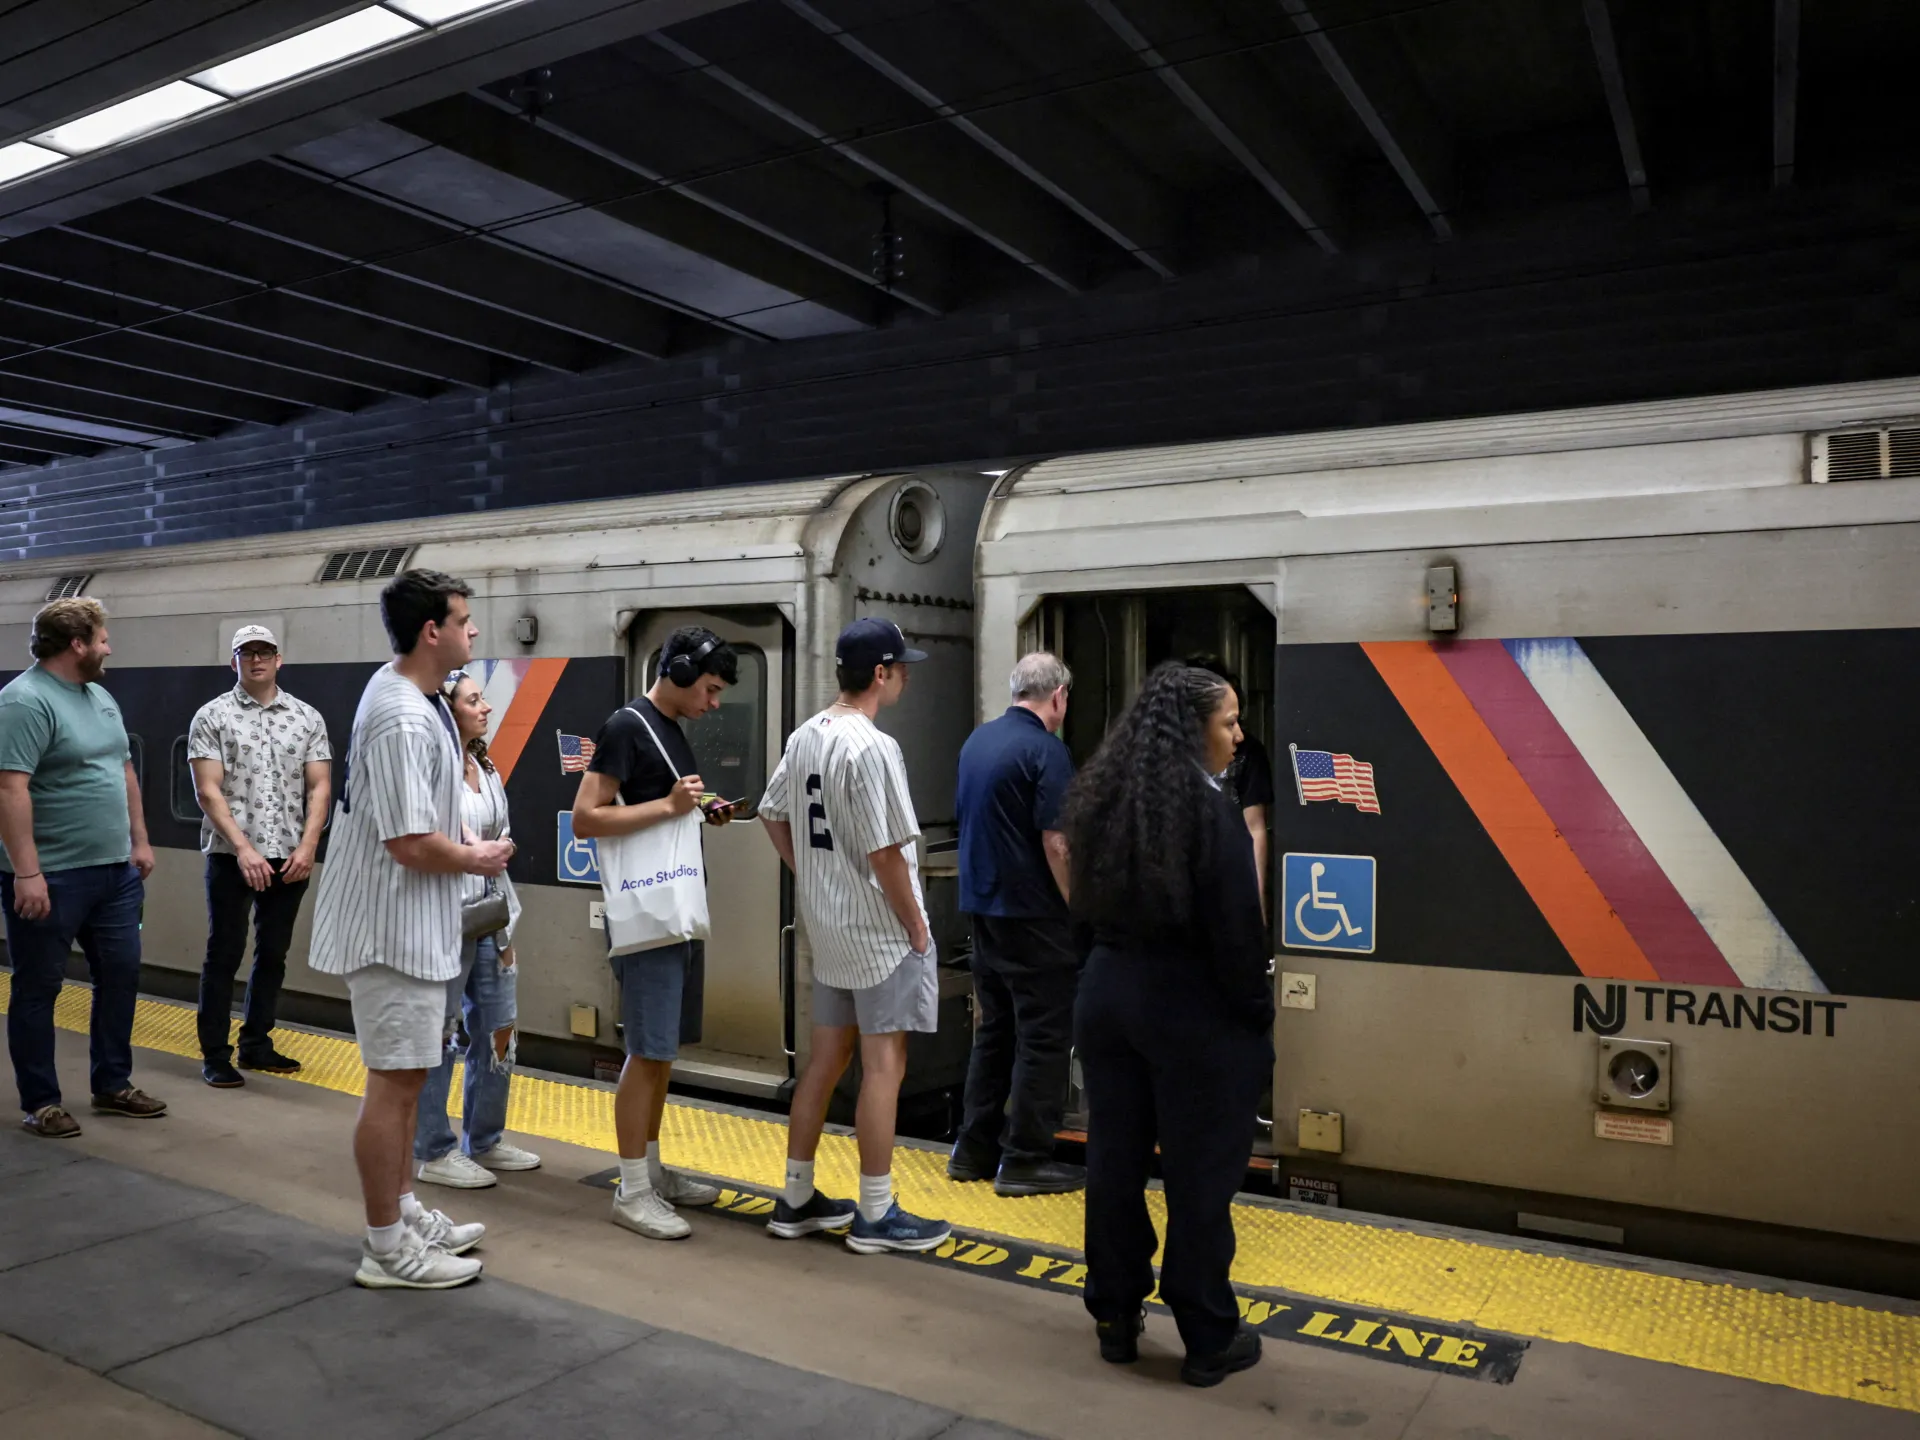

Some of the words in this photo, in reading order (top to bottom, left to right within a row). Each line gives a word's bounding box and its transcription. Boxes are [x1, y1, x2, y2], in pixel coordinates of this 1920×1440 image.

[806, 773, 834, 851] 2
[620, 879, 654, 892] Acne
[656, 864, 698, 883] Studios
[1573, 983, 1627, 1035] NJ
[1634, 986, 1847, 1037] TRANSIT
[1290, 1176, 1338, 1192] DANGER
[1297, 1311, 1487, 1368] LINE
